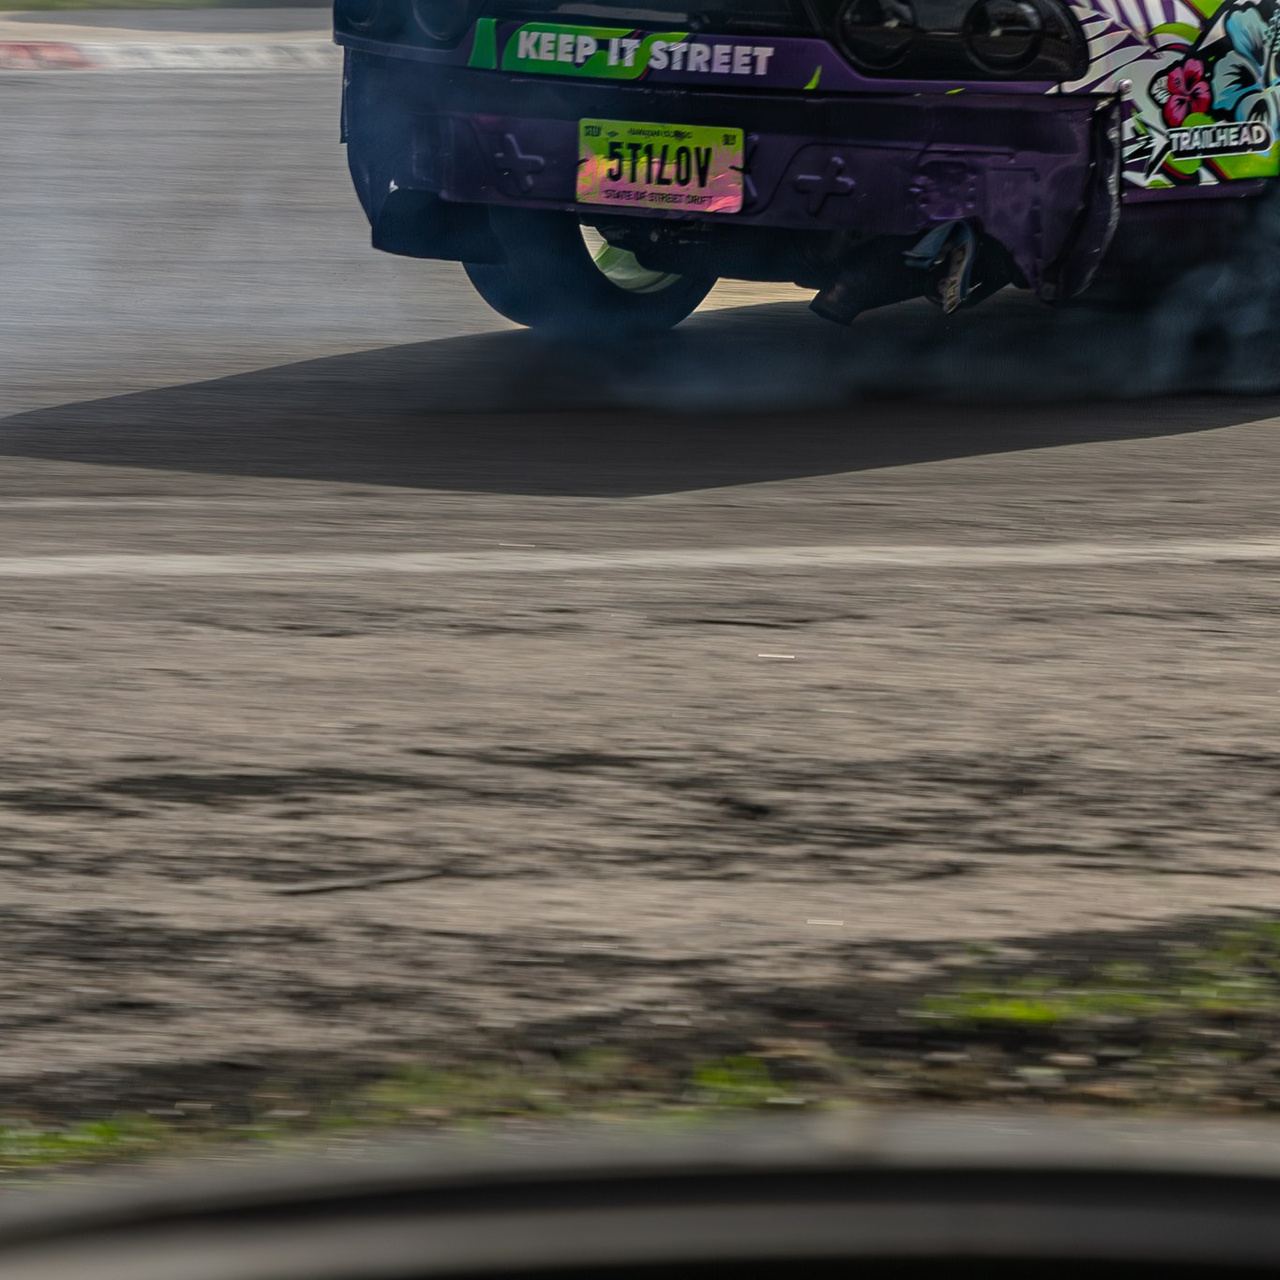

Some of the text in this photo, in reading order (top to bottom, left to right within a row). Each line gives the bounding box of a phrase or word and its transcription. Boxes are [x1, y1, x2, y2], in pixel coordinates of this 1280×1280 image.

[517, 30, 775, 75] KEEP IT STREET
[1169, 125, 1267, 151] TRAILHEAD
